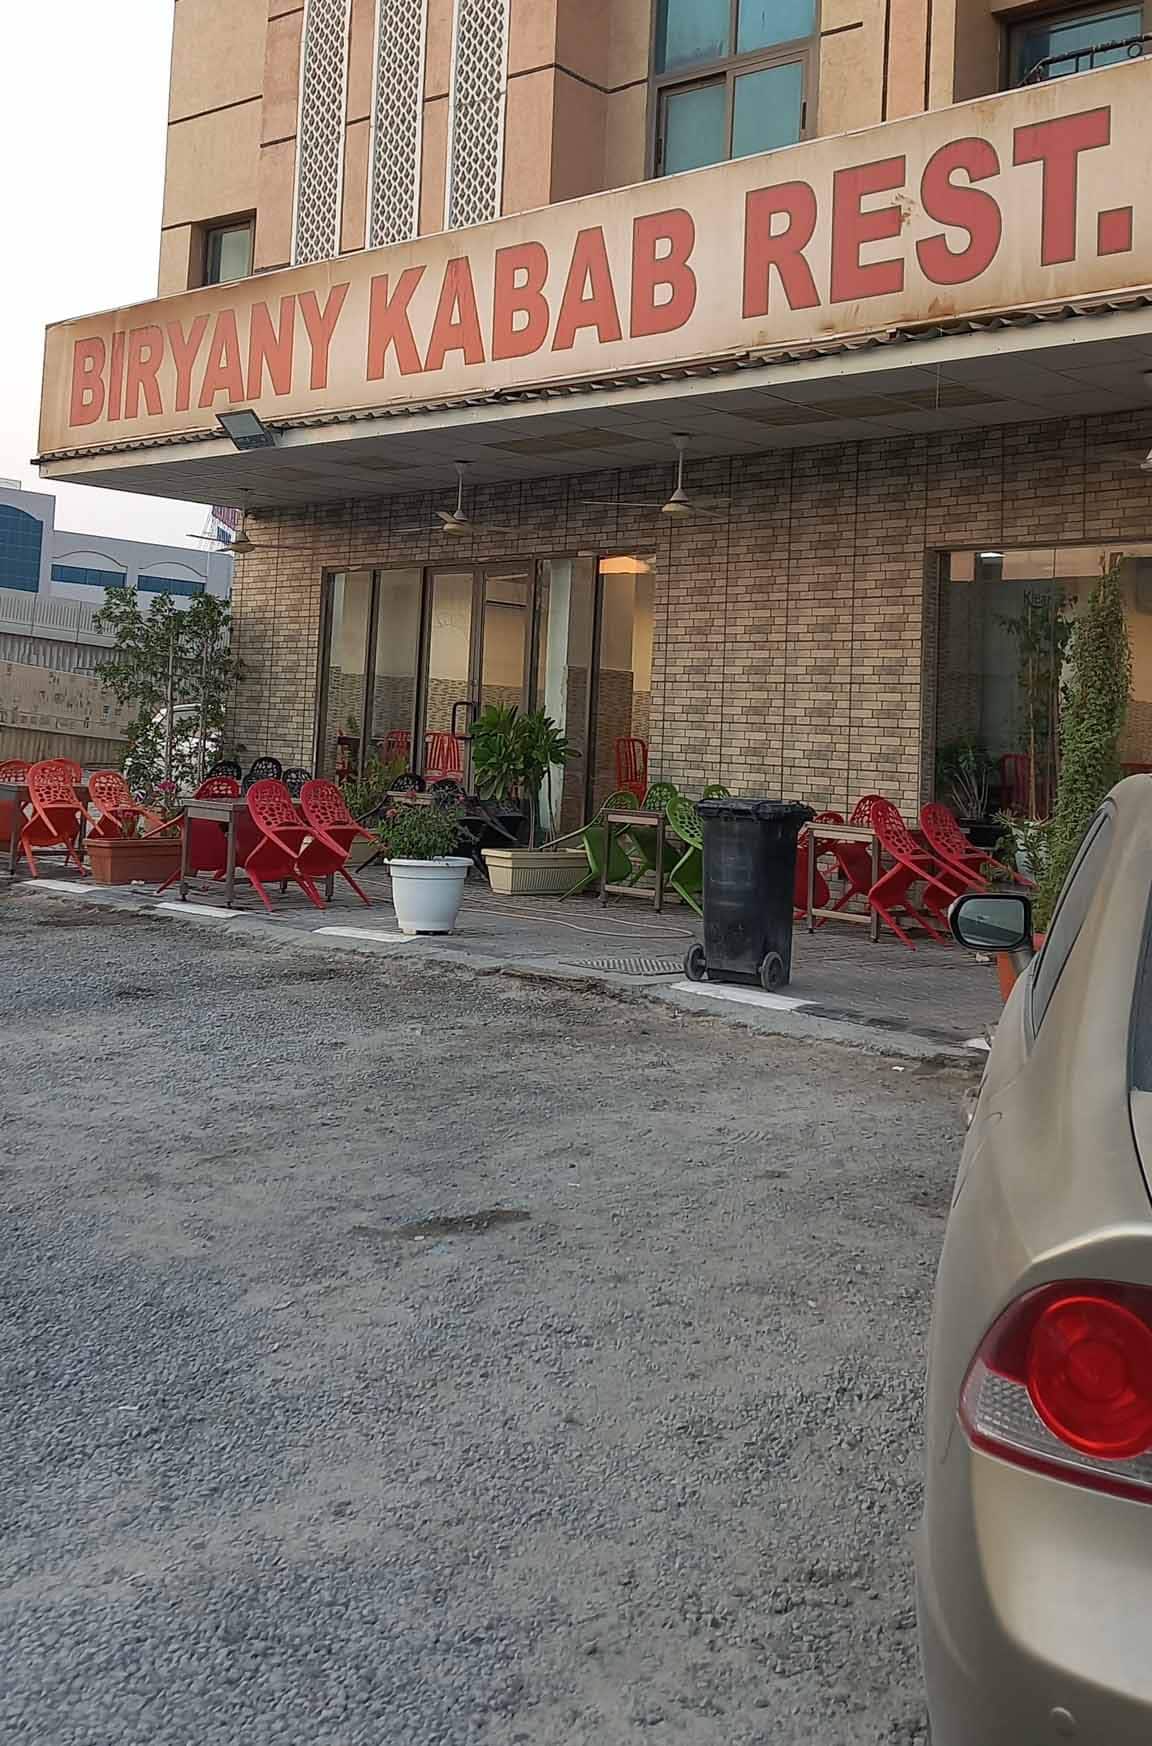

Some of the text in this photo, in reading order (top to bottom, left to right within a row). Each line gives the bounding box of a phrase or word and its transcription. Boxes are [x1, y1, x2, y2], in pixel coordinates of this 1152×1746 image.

[69, 105, 1133, 427] BIRYANY KABAB REST.
